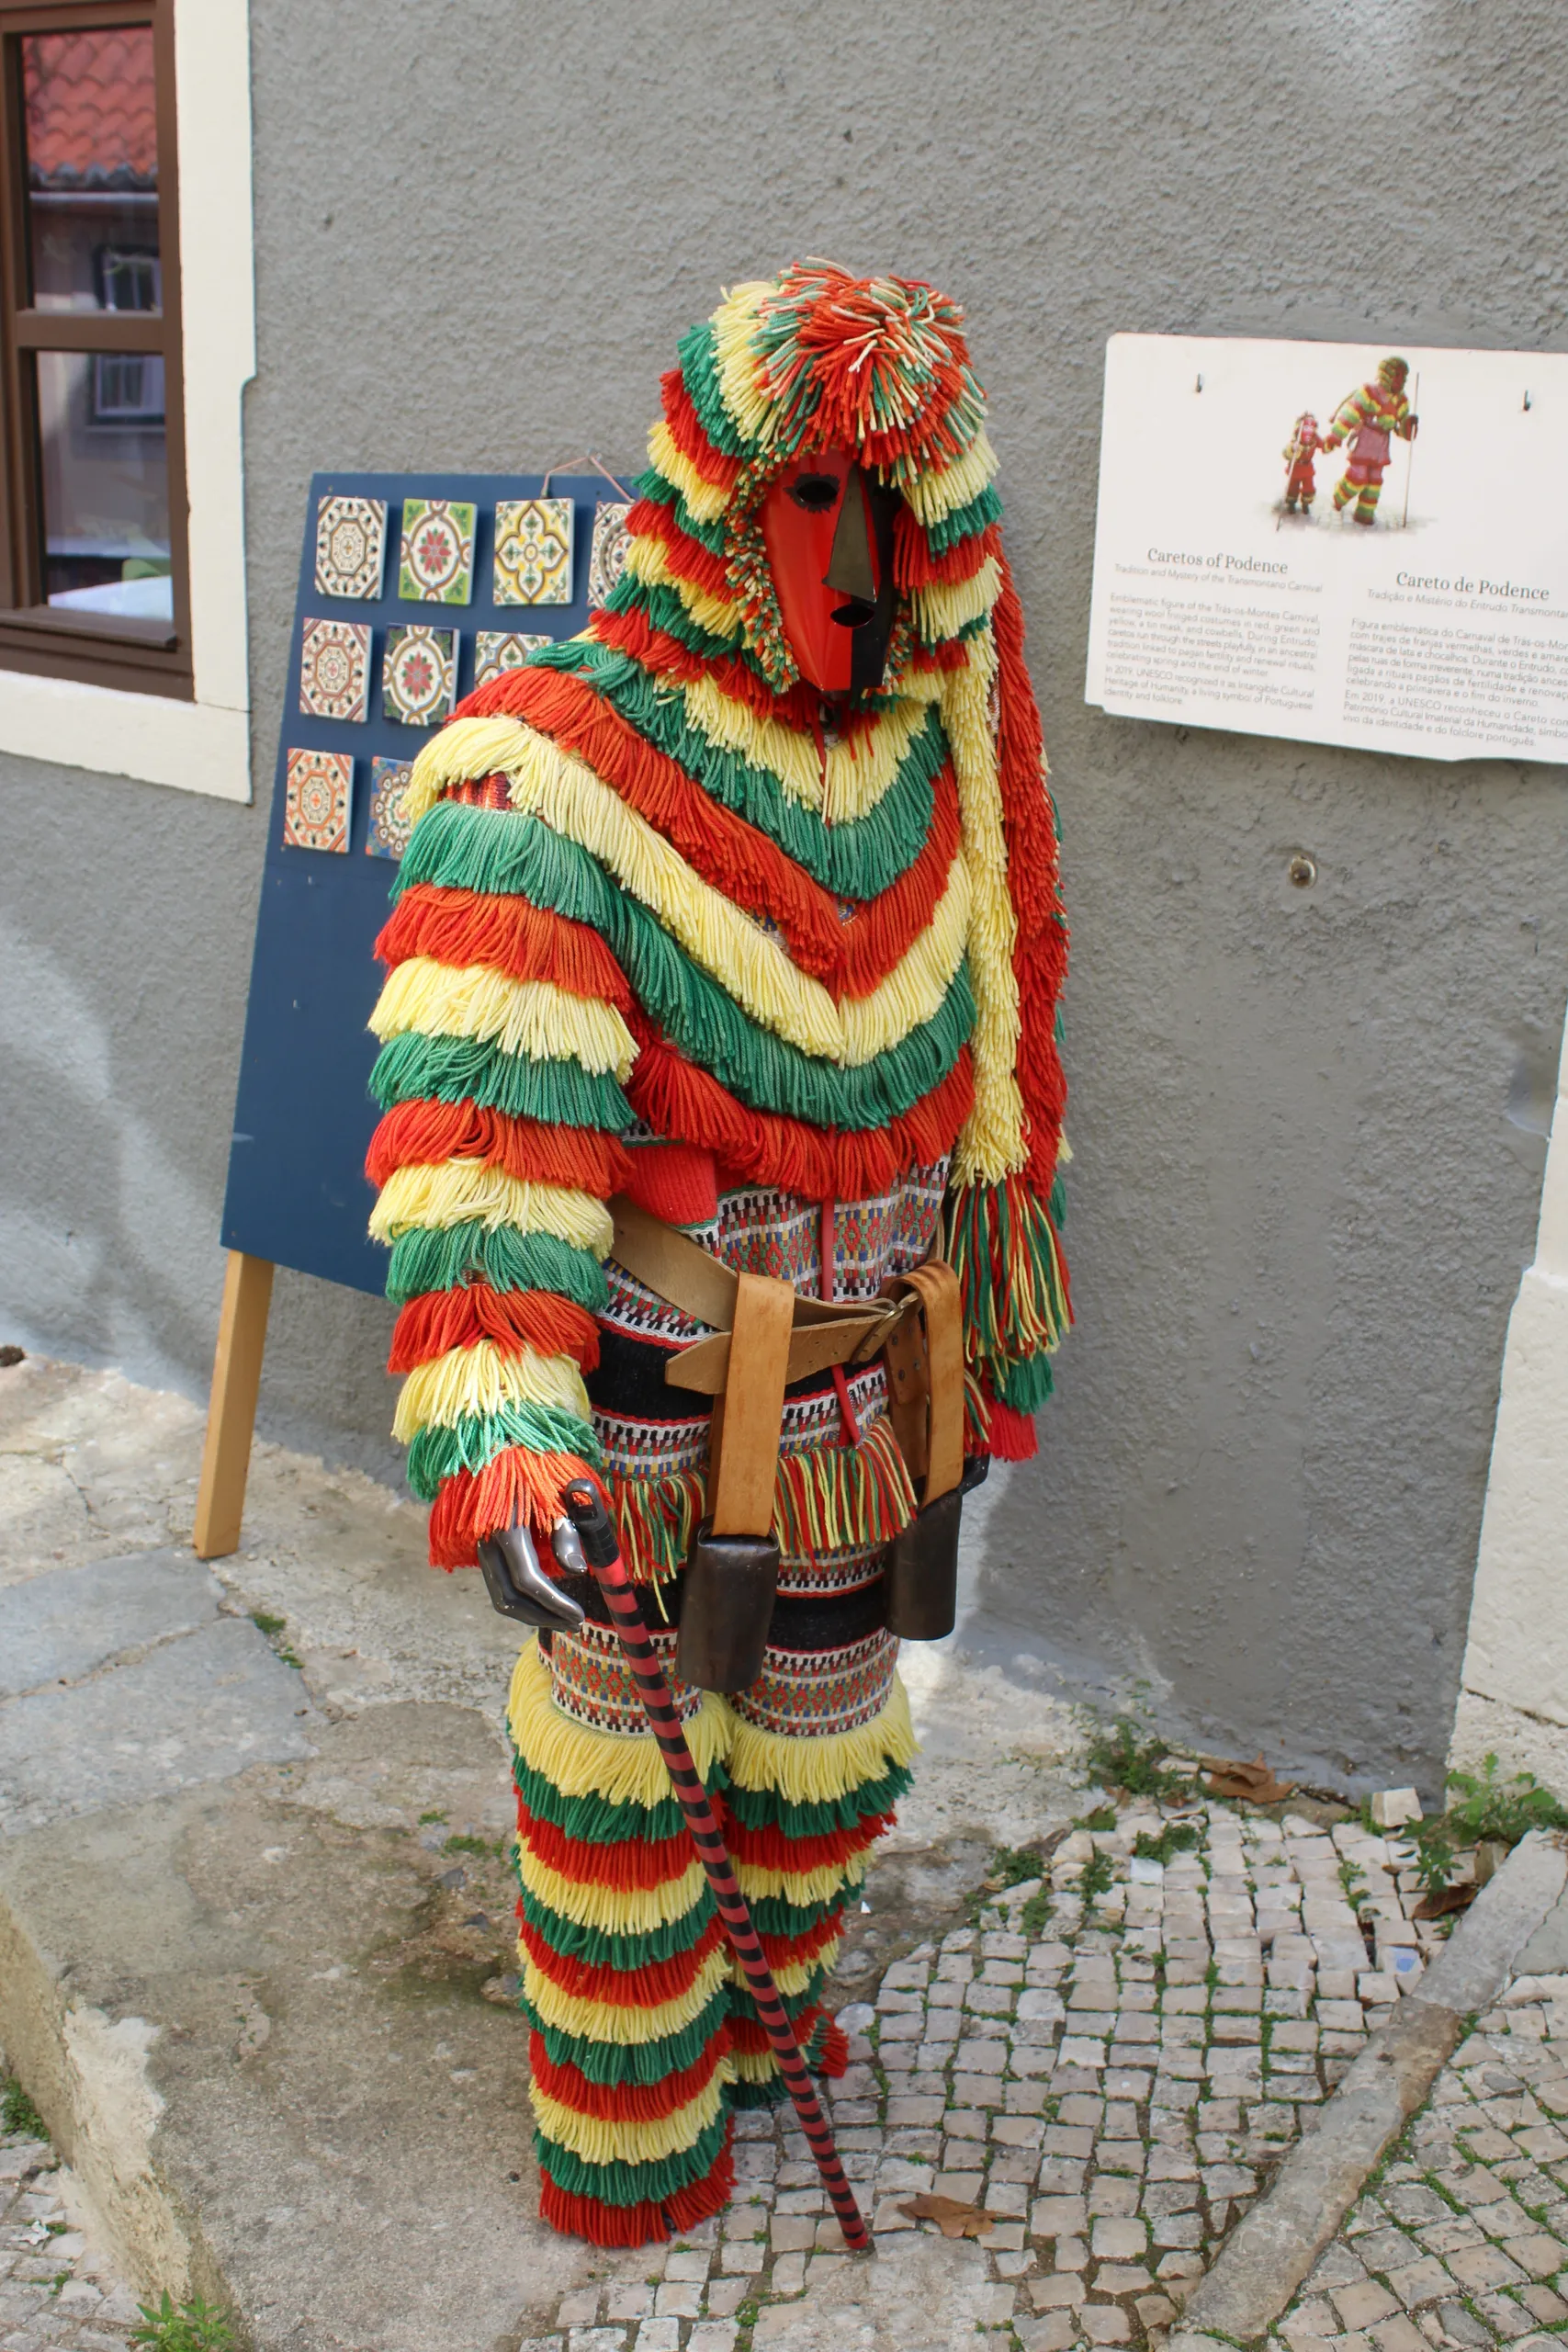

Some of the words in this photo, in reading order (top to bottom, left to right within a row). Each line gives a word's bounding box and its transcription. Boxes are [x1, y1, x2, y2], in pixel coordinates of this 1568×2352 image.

[1148, 547, 1201, 565] Caretos
[1206, 554, 1221, 567] of
[1225, 555, 1288, 574] Podence
[1396, 571, 1450, 590] Careto
[1454, 577, 1473, 593] de
[1479, 580, 1549, 600] Podence
